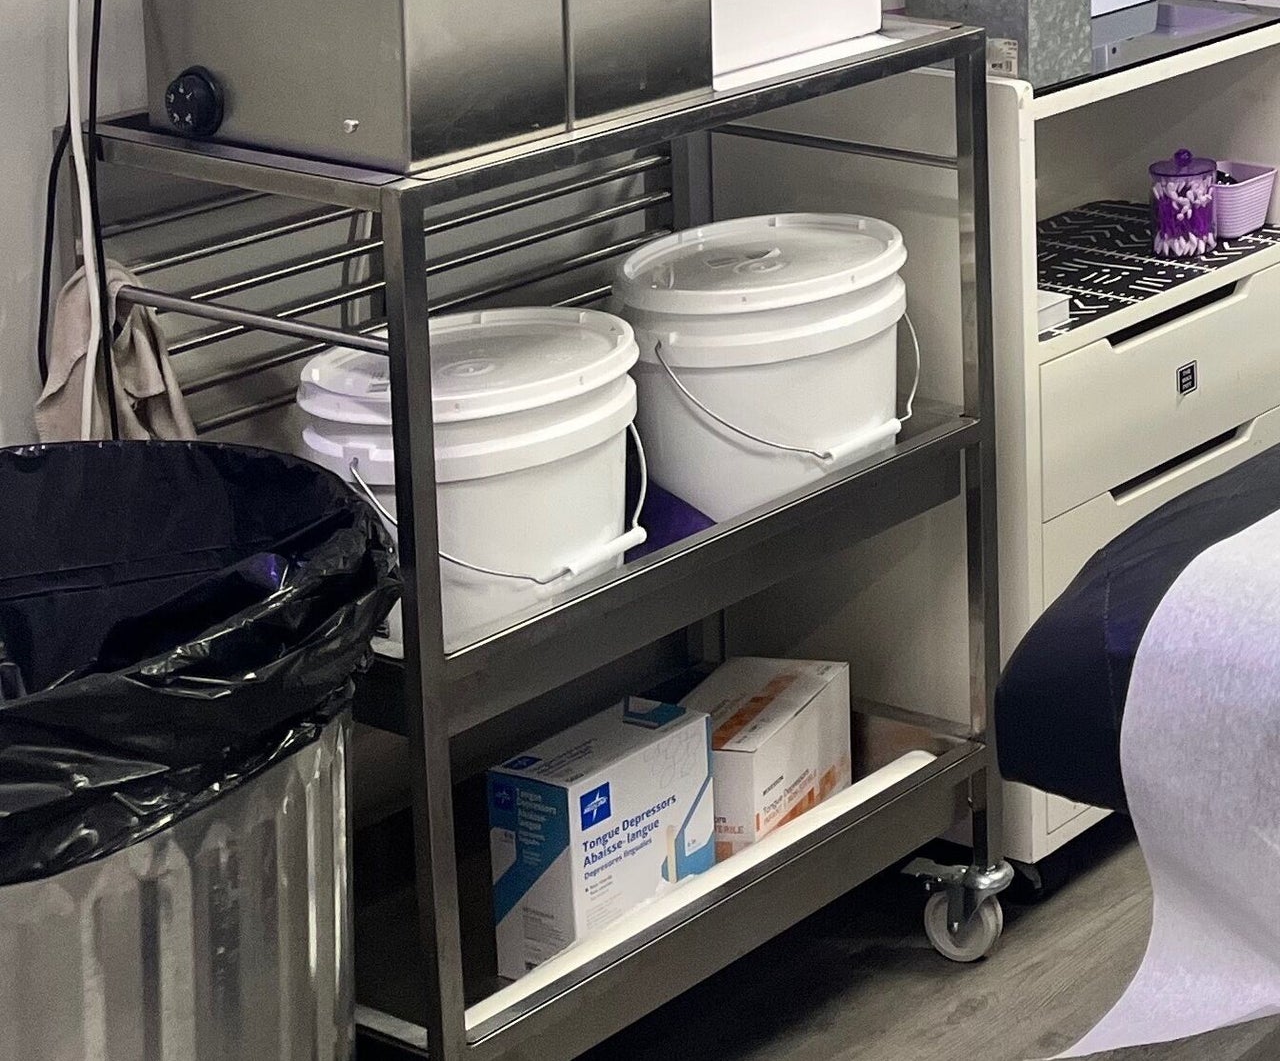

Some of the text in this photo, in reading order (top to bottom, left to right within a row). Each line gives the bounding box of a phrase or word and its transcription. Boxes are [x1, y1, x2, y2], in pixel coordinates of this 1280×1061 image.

[582, 826, 621, 853] Tongue
[622, 794, 677, 832] Depressors
[583, 819, 660, 868] Abaisse-langue
